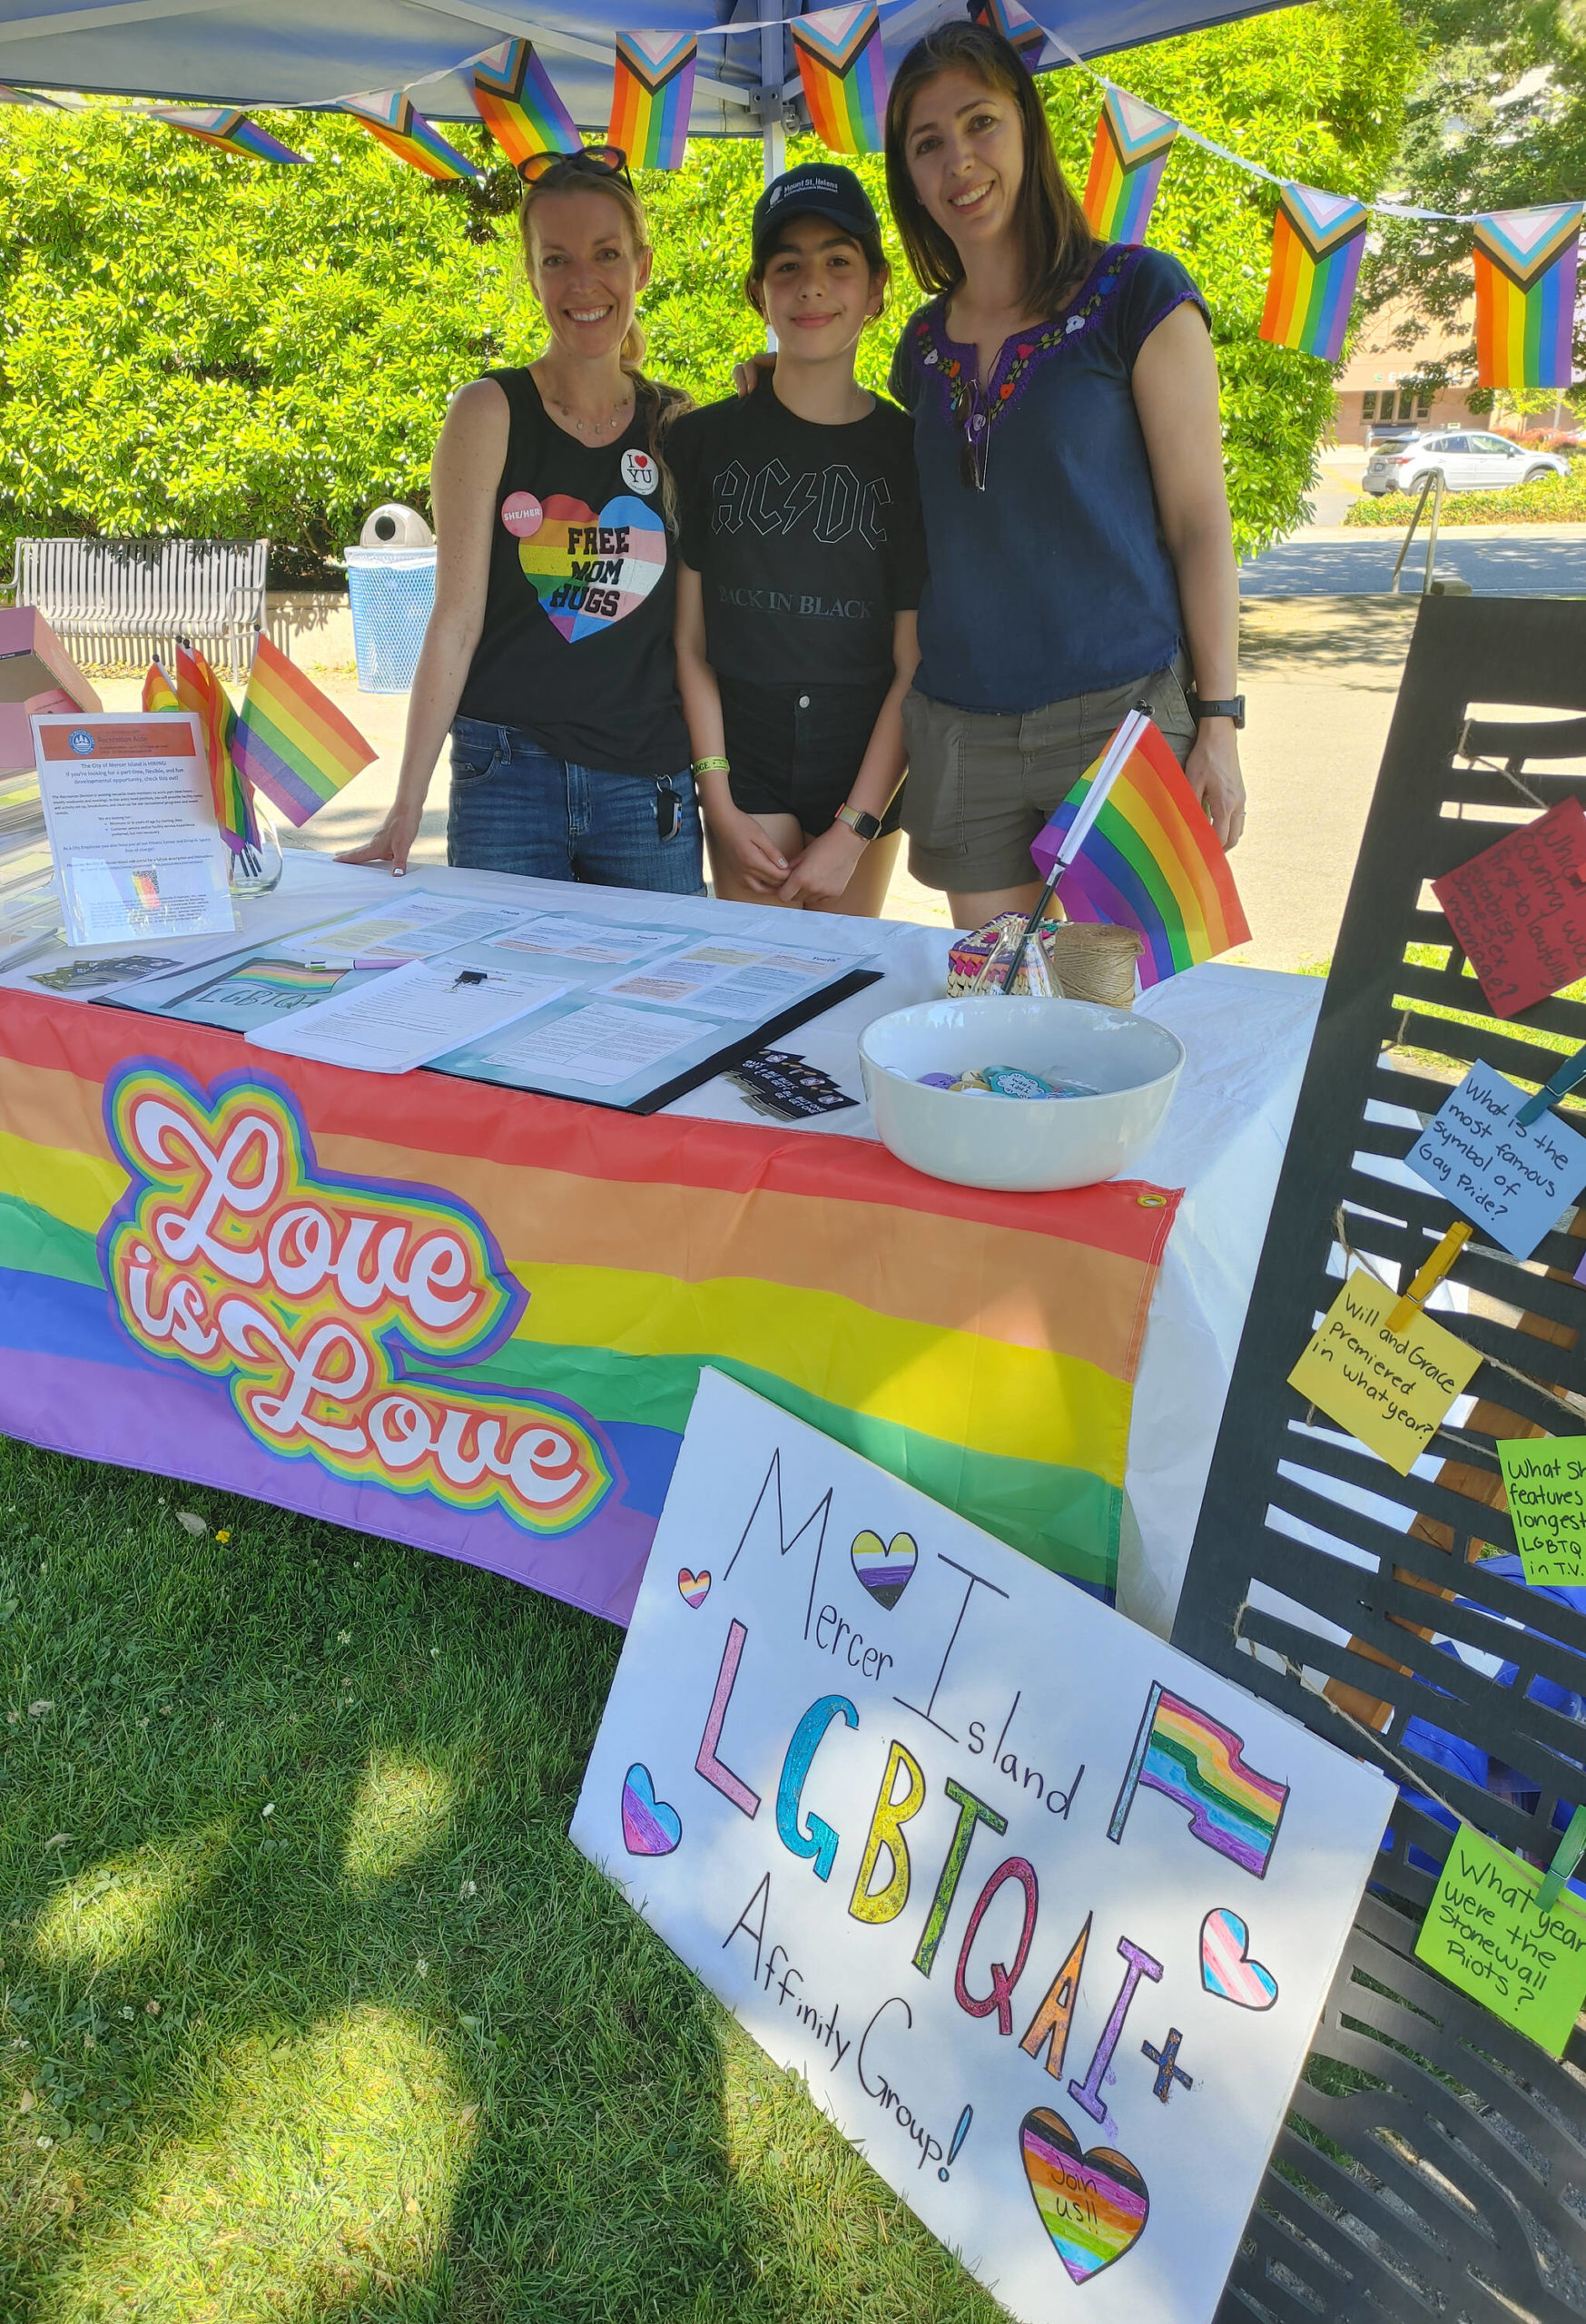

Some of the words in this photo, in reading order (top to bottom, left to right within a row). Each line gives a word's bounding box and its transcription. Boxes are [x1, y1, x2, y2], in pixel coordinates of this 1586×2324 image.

[504, 507, 541, 522] SHE/HER
[626, 468, 652, 483] YU
[567, 526, 630, 555] FREE
[571, 558, 625, 586] MOM
[549, 584, 621, 617] HUGS
[769, 591, 793, 611] IN
[798, 595, 873, 618] BLACK
[1536, 815, 1586, 897] Whic
[1448, 1104, 1492, 1137] most
[1496, 1144, 1555, 1197] famous
[1464, 1078, 1510, 1118] What
[1507, 1118, 1528, 1138] is
[1532, 1134, 1570, 1170] the
[134, 1098, 478, 1327] Love
[1419, 1143, 1452, 1181] Gay
[1456, 1173, 1508, 1221] Pride?
[1493, 1175, 1522, 1196] of
[129, 1246, 219, 1355] is
[218, 1300, 586, 1503] Love
[1345, 1293, 1379, 1328] Will
[1379, 1329, 1407, 1355] and
[1407, 1346, 1455, 1394] Grace
[1312, 1342, 1334, 1363] in
[1343, 1364, 1389, 1406] what
[1381, 1402, 1434, 1441] year?
[1507, 1458, 1561, 1480] What
[1510, 1482, 1584, 1506] features
[1516, 1510, 1586, 1537] longest
[1522, 1536, 1582, 1560] LGBTQ
[1530, 1561, 1549, 1576] in
[724, 1447, 894, 1681] Mercer
[892, 1552, 1085, 1820] Island
[694, 1618, 1194, 2123] LGBTQAI+
[1459, 1849, 1535, 1914] What
[1530, 1910, 1586, 1953] year
[1439, 1904, 1548, 1991] Stonewall
[1444, 1880, 1496, 1925] were
[1506, 1925, 1557, 1969] the
[722, 1871, 851, 2073] Affinity
[857, 1997, 973, 2182] Group!
[1050, 2155, 1098, 2194] Join
